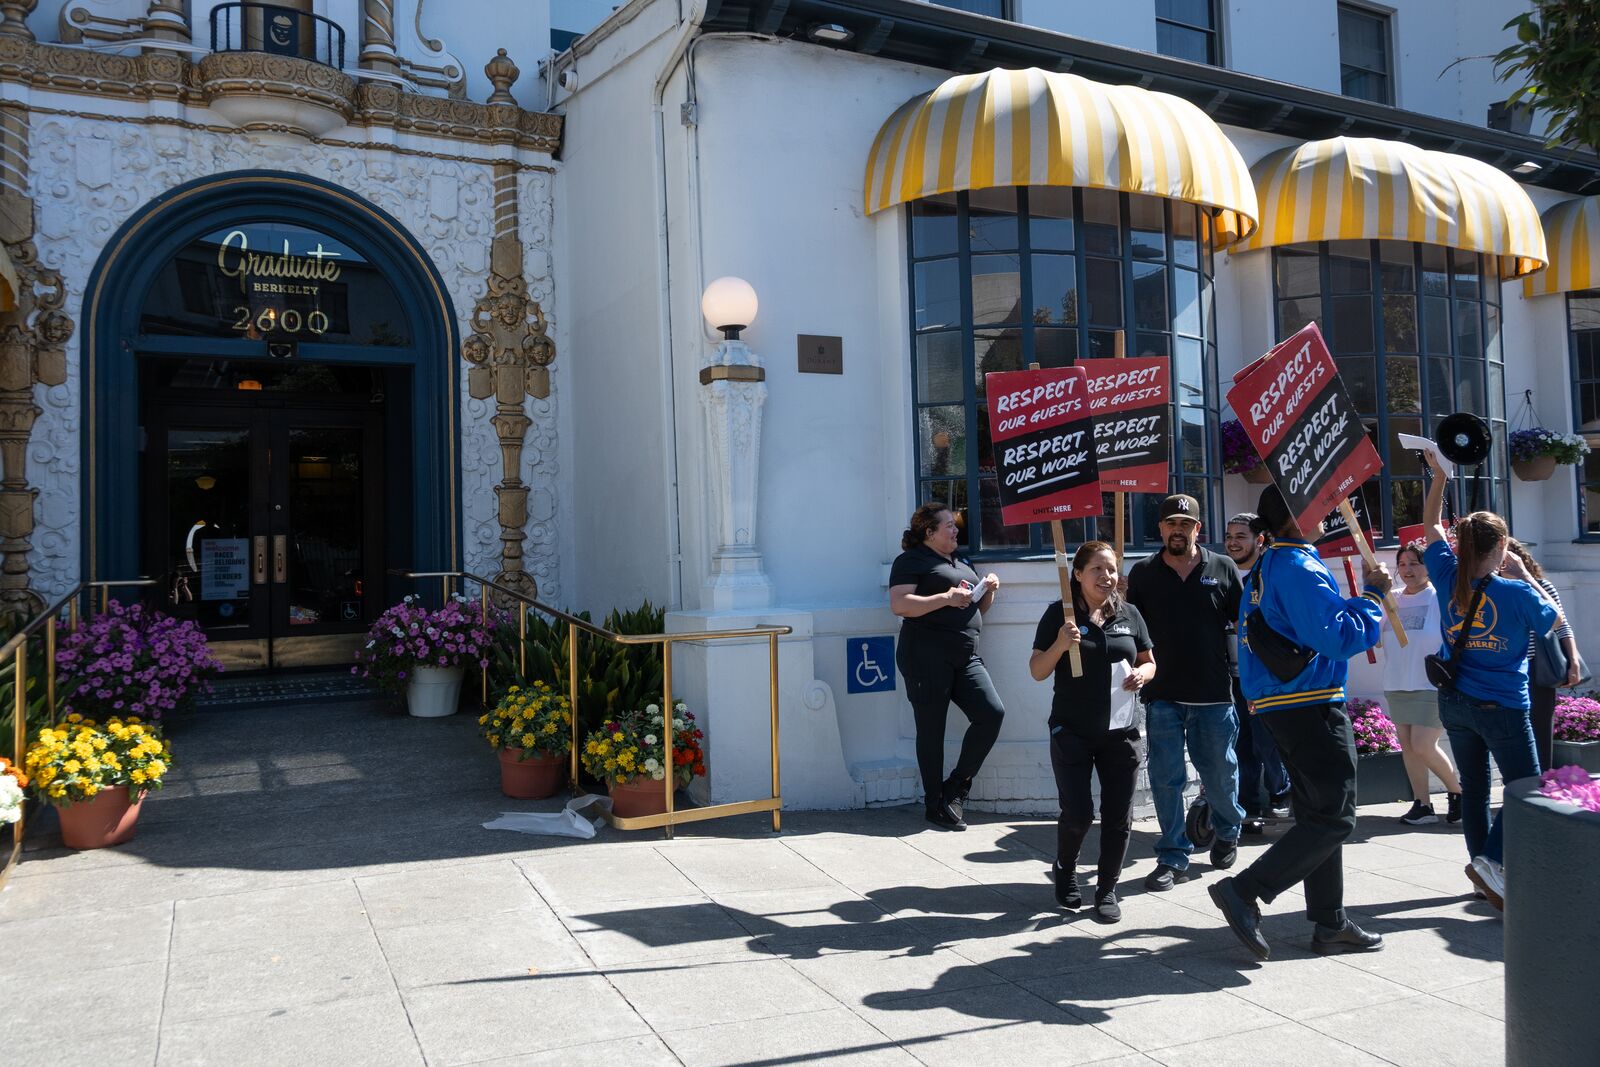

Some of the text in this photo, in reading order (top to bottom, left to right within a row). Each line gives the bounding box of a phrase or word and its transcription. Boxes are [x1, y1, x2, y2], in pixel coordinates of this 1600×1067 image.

[218, 230, 341, 294] Graduate
[253, 282, 319, 295] BERKELEY
[232, 306, 329, 334] 2600
[997, 377, 1078, 414] RESPECT
[1087, 366, 1160, 394] RESPECT
[1089, 386, 1161, 410] UR GUESTS
[1249, 340, 1312, 426] RESPECT
[999, 398, 1082, 432] OUR GUESTS
[1261, 360, 1325, 445] OUR GUESTS
[1093, 415, 1160, 438] ESPECT
[1115, 433, 1161, 452] WORK
[1277, 392, 1339, 476] RESPECT
[1003, 431, 1085, 467] RESPECT
[1289, 459, 1313, 495] OUR
[1313, 411, 1349, 462] WORK
[1005, 466, 1037, 486] OUR
[1041, 450, 1088, 475] WORK
